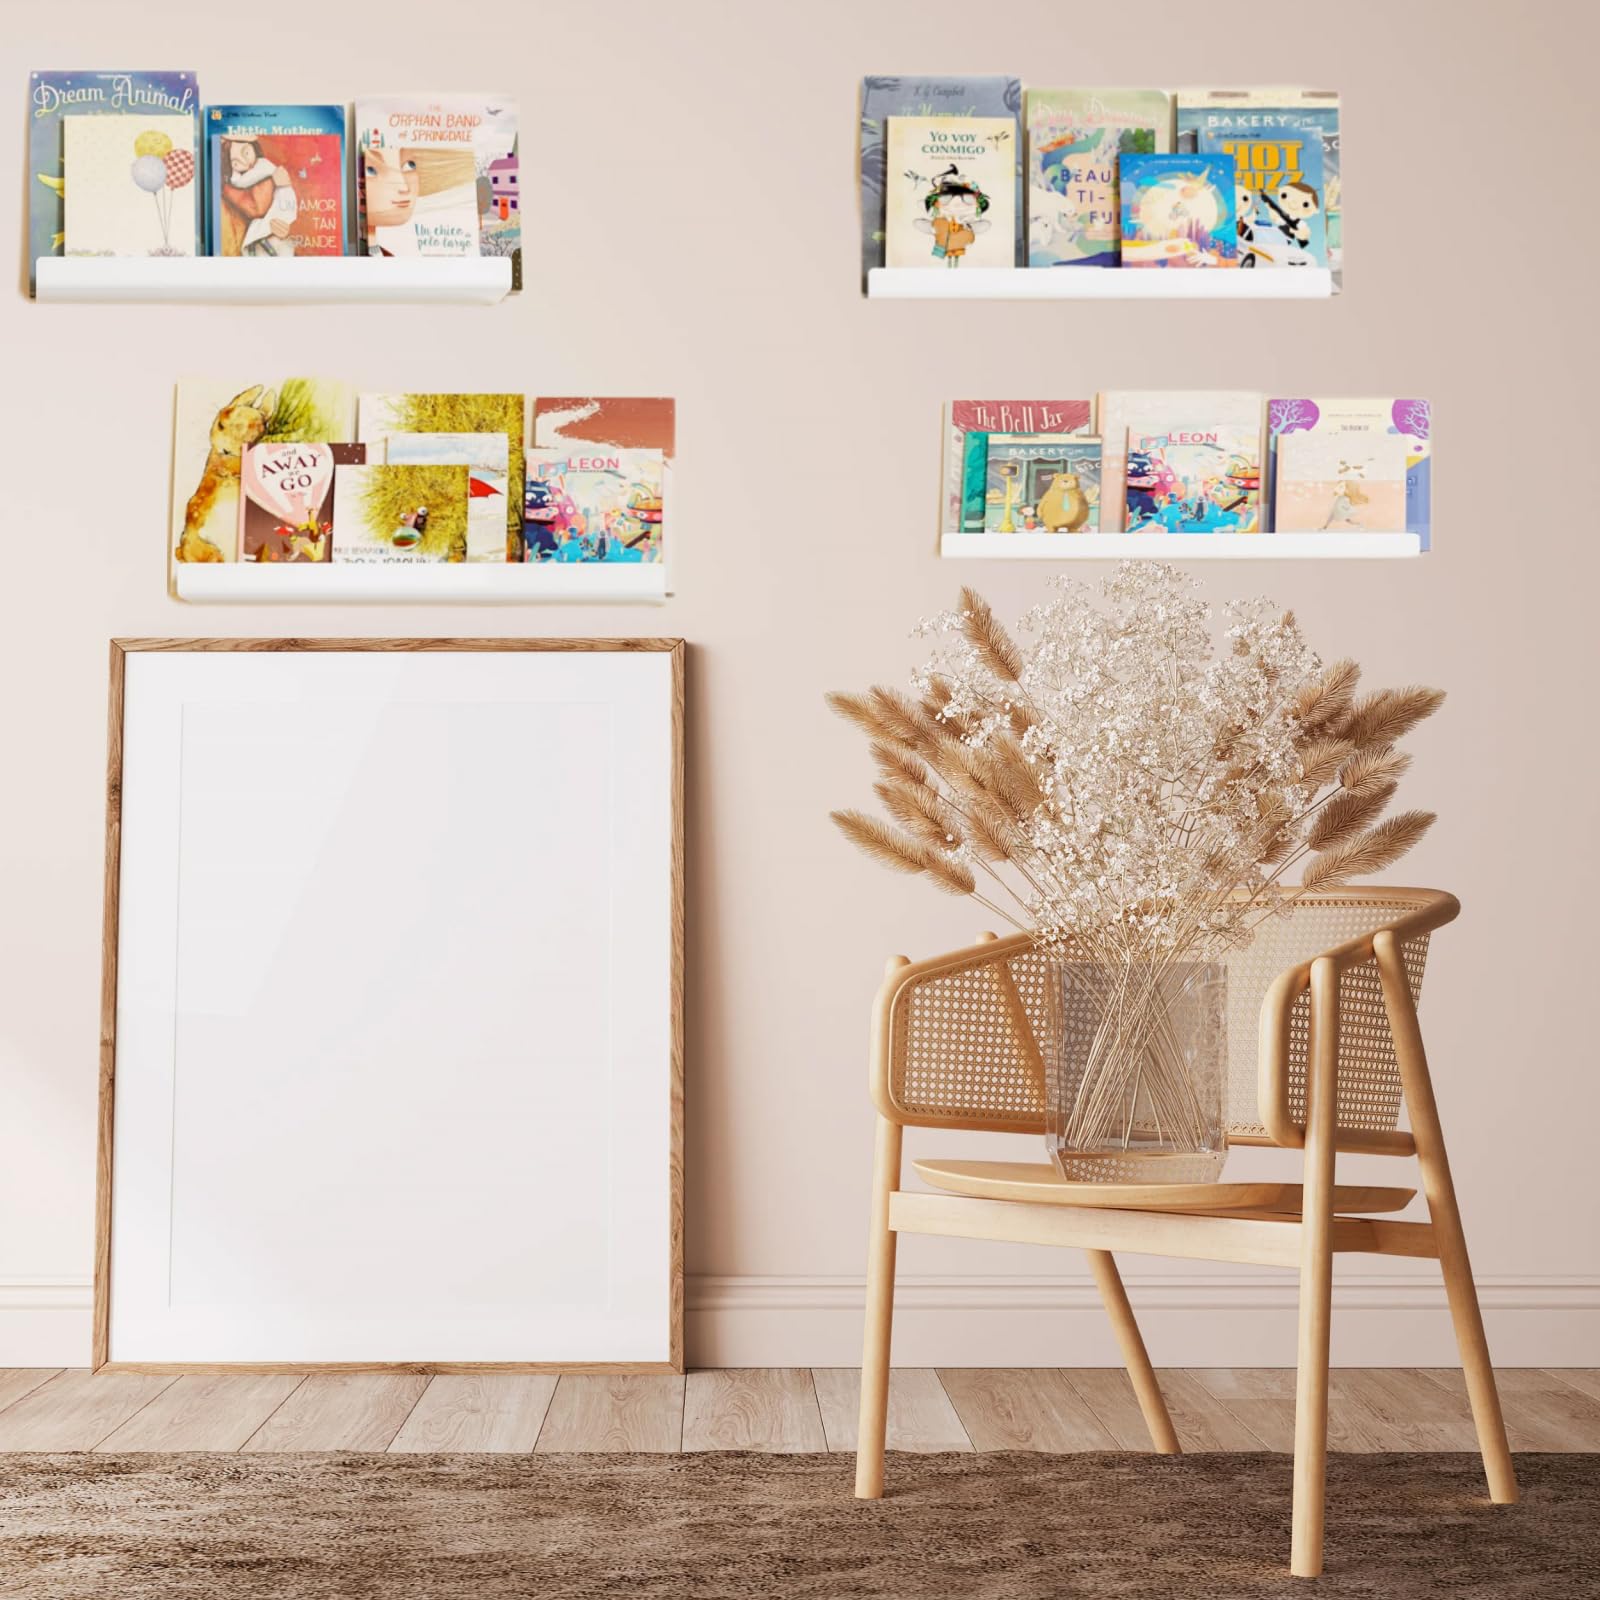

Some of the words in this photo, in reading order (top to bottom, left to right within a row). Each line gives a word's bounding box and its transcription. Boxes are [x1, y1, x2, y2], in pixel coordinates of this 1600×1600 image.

[33, 81, 106, 118] Dream
[111, 78, 194, 115] Animals
[388, 113, 442, 128] ORPHAN
[446, 113, 481, 128] BAND
[1207, 115, 1288, 128] BAKERY
[412, 129, 472, 142] SPRINGDALE
[921, 144, 986, 154] CONMIGO
[1060, 169, 1111, 183] BEAU
[299, 199, 337, 211] AMOR
[312, 217, 336, 230] TAN
[974, 406, 996, 430] The
[1000, 405, 1035, 432] Bell
[1040, 406, 1065, 430] Jar
[1168, 432, 1217, 443] LEON
[1008, 447, 1065, 456] BAKERY
[262, 453, 321, 479] AWAY
[568, 457, 619, 470] LEON
[280, 474, 312, 491] GO
